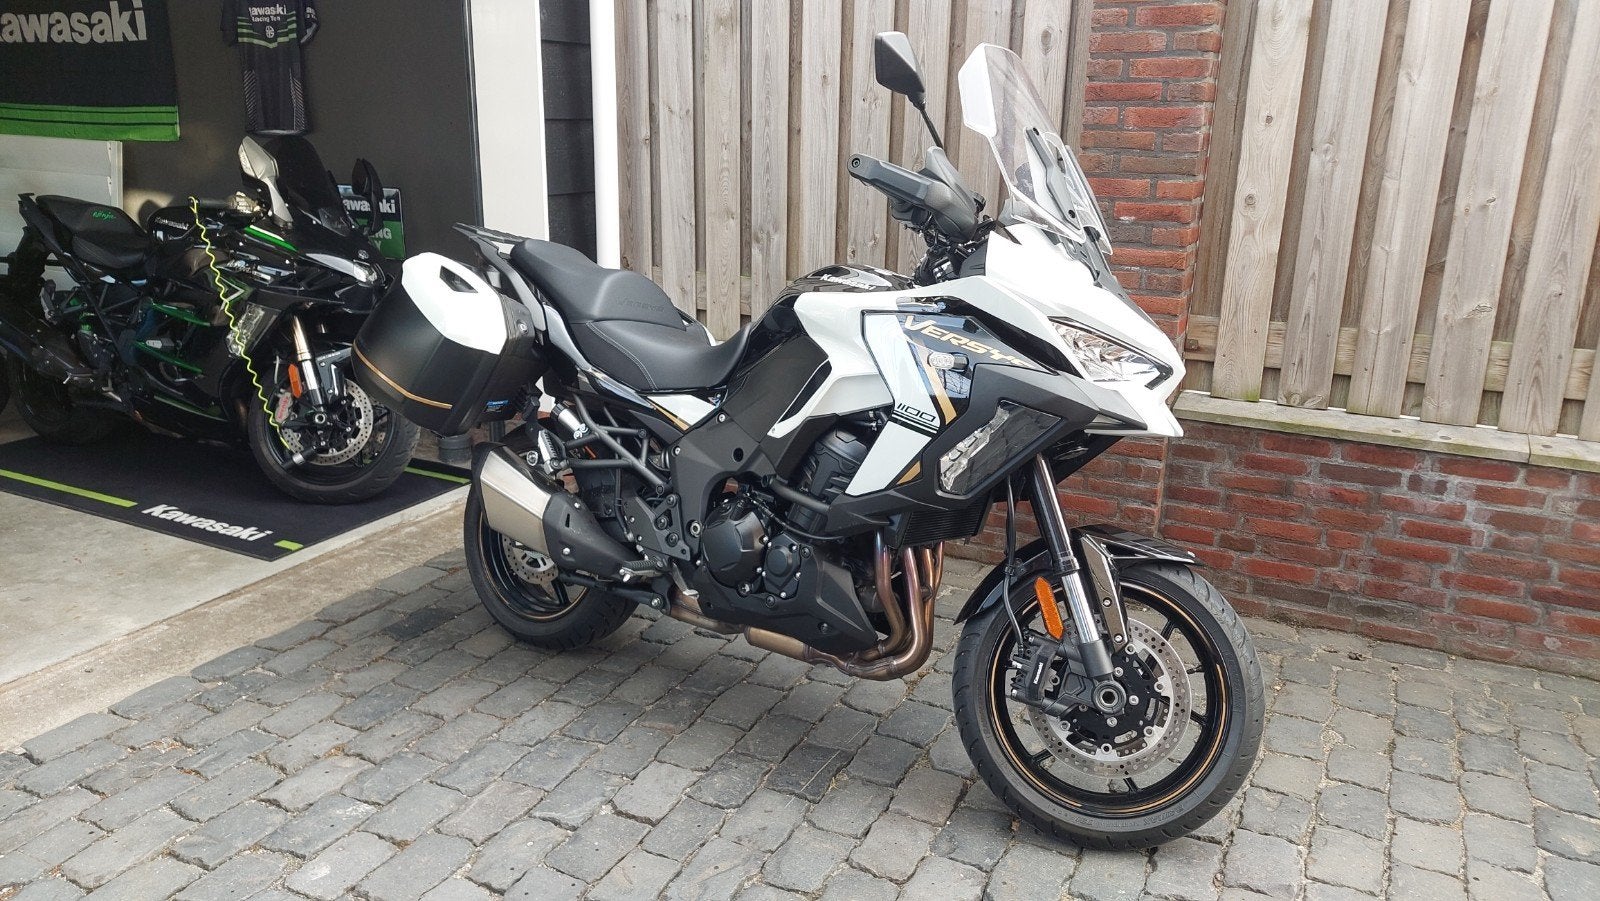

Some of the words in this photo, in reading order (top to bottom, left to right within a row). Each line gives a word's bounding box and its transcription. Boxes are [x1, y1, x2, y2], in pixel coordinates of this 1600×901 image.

[0, 0, 147, 44] awasaki
[820, 273, 877, 291] Kawasaki
[141, 503, 274, 541] Kawasaki
